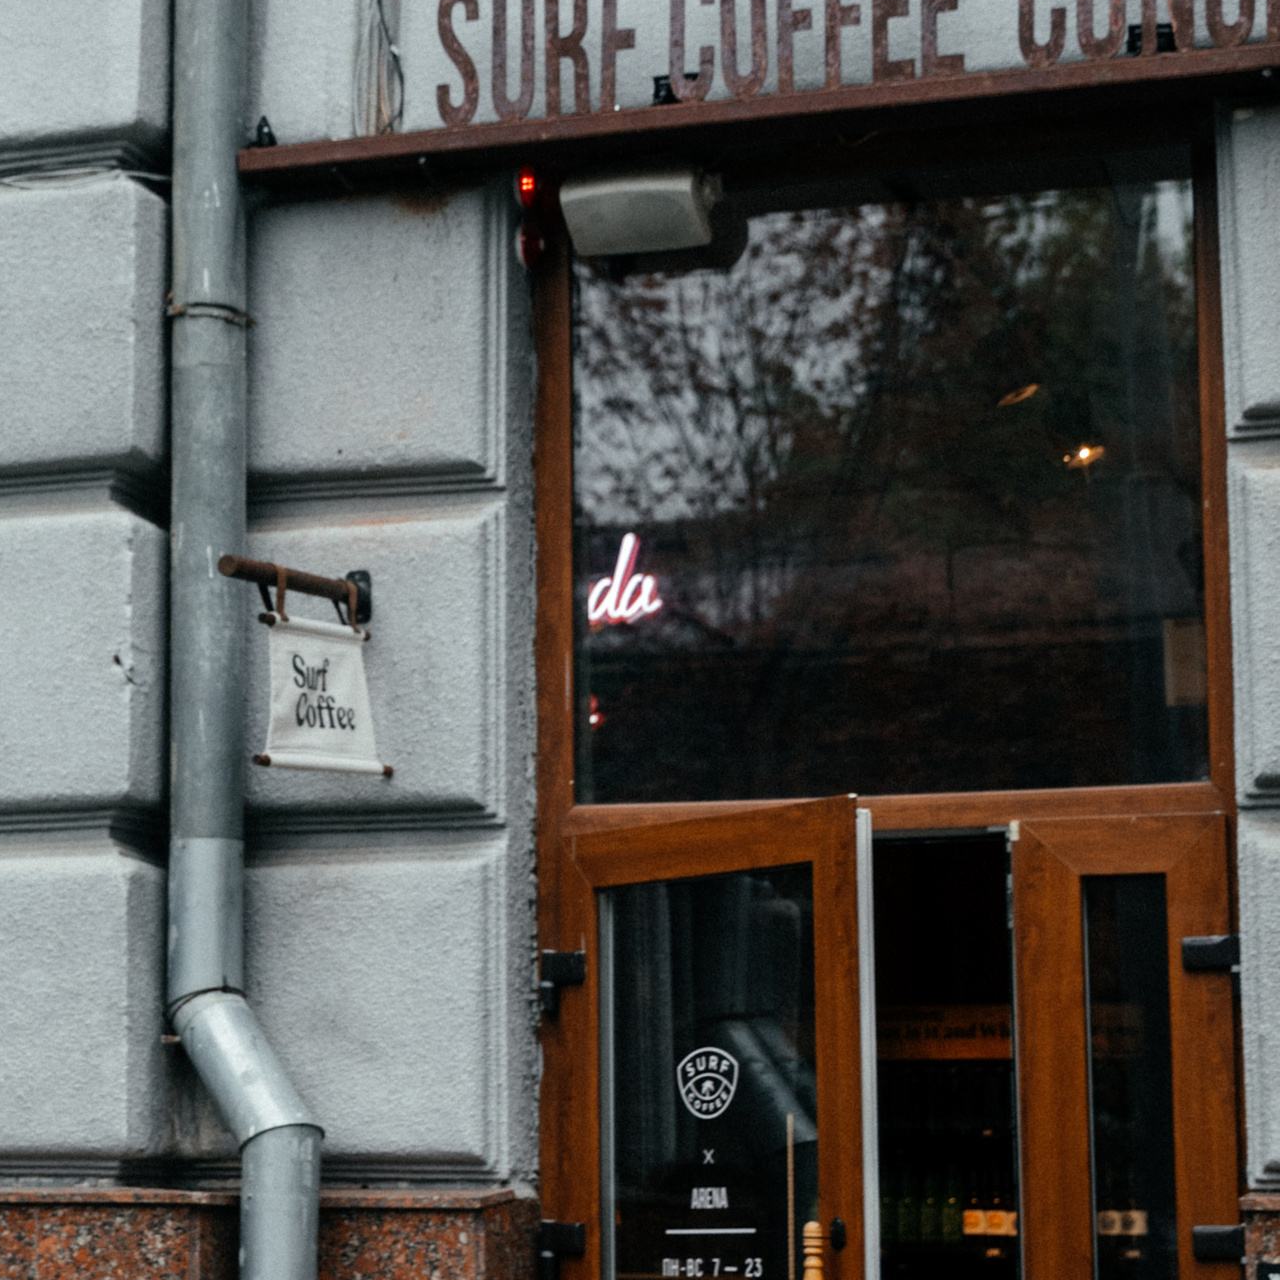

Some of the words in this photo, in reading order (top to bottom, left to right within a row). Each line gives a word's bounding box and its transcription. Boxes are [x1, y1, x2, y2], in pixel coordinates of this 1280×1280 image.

[292, 654, 329, 692] Surf
[295, 692, 356, 730] Coffee
[685, 1055, 730, 1077] SURF
[687, 1091, 729, 1112] COFFEE
[691, 1187, 728, 1209] ARENA
[662, 1258, 704, 1277] ПН-ВС
[744, 1258, 763, 1277] 23
